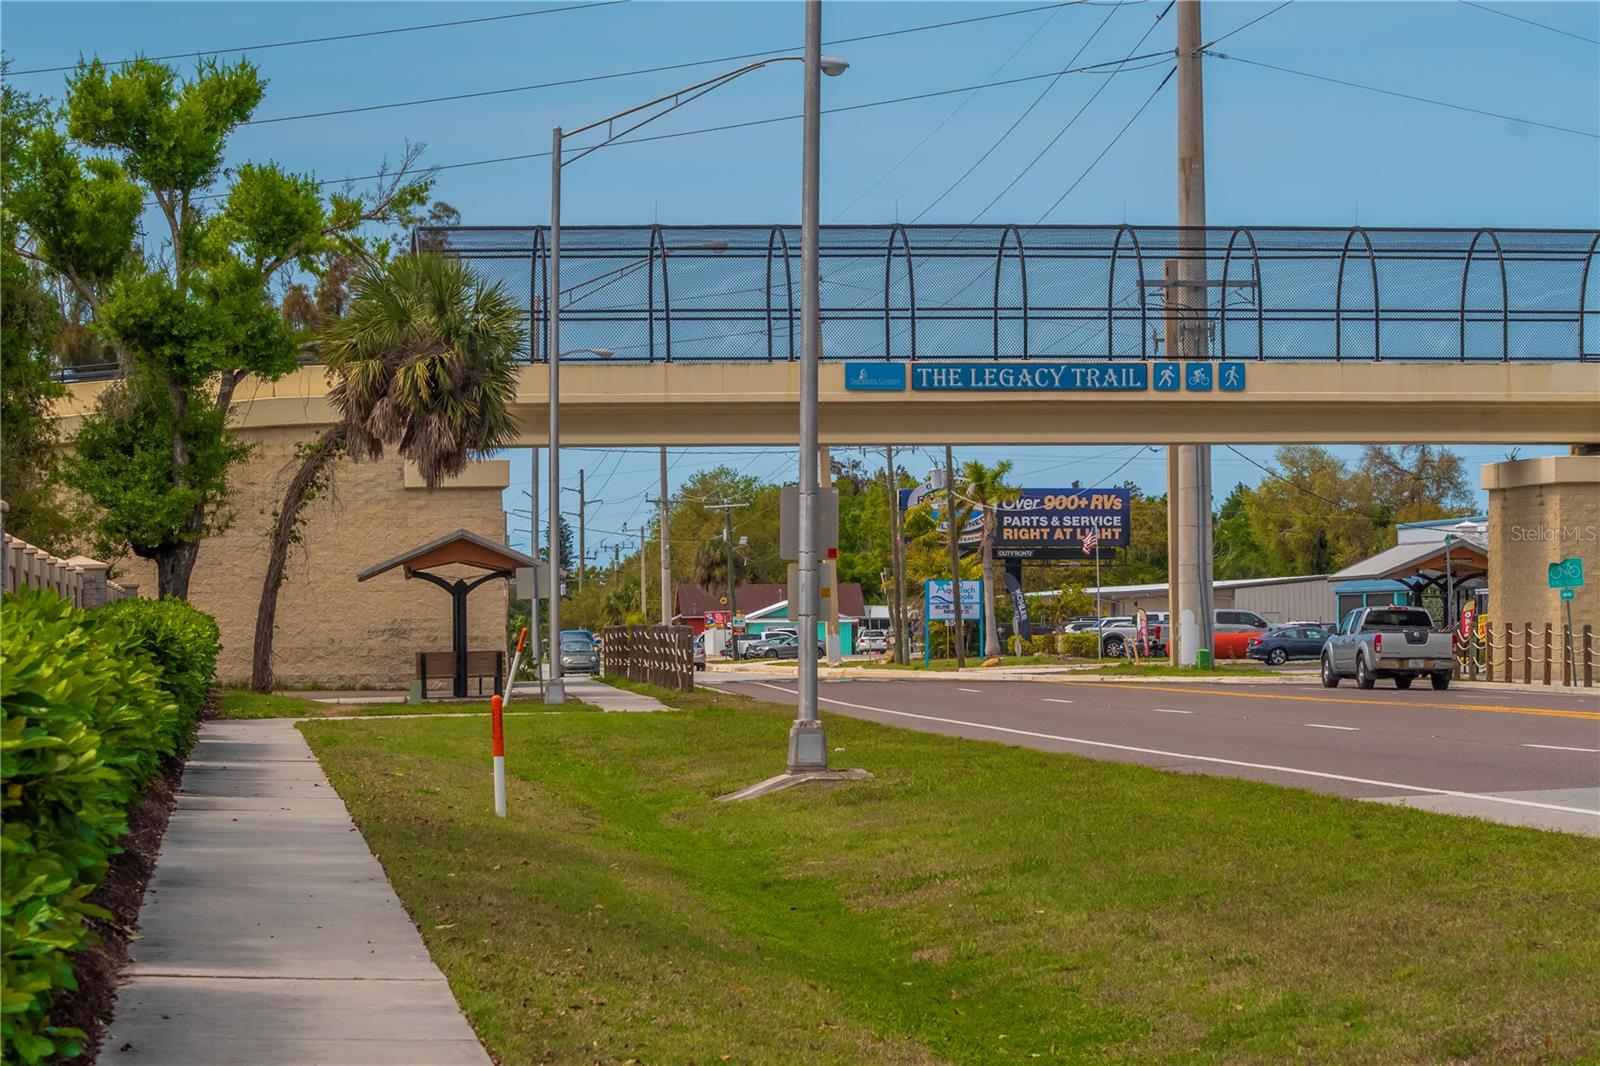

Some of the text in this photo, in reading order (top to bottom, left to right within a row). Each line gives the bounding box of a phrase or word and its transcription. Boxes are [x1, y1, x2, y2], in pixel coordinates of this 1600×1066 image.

[917, 364, 1142, 387] THE LEGACY TRAIL
[1002, 494, 1122, 510] Over 900+ RVs
[1003, 516, 1122, 526] PARTS & SERVICE
[1003, 528, 1050, 540] RIGHT
[1053, 528, 1073, 540] AT
